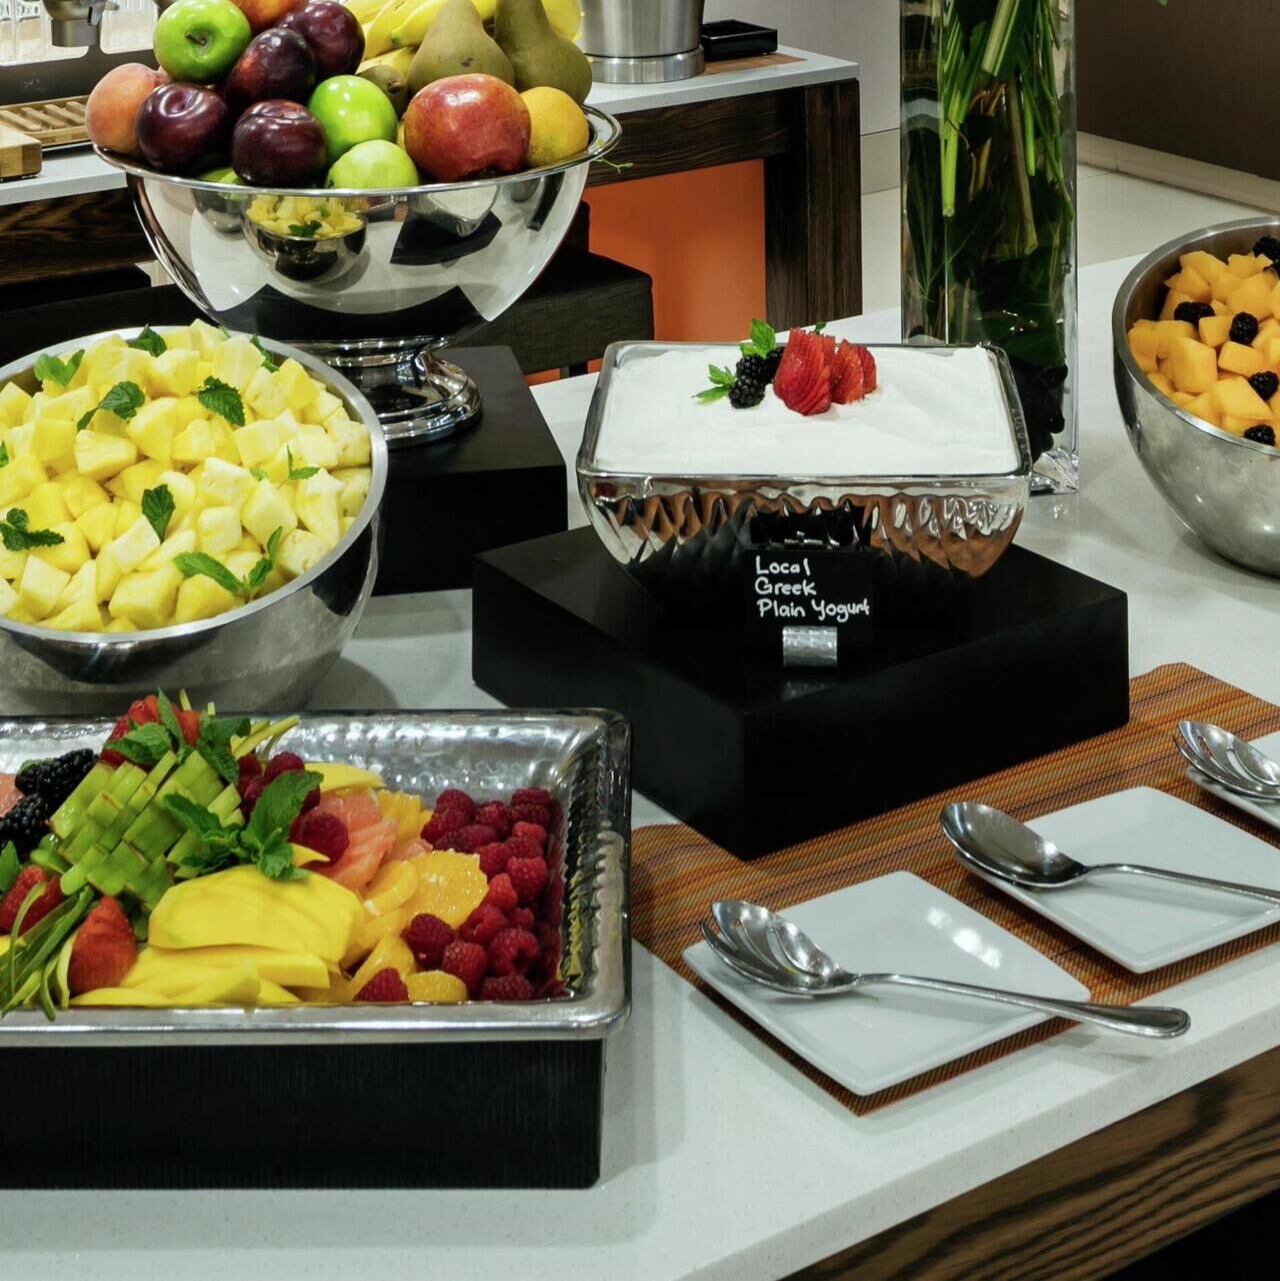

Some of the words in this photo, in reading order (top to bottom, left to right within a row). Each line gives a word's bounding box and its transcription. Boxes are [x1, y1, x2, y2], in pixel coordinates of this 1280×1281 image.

[755, 555, 811, 576] Local
[754, 576, 817, 596] Greek
[756, 598, 806, 618] Plain
[811, 598, 870, 623] Yogurt
